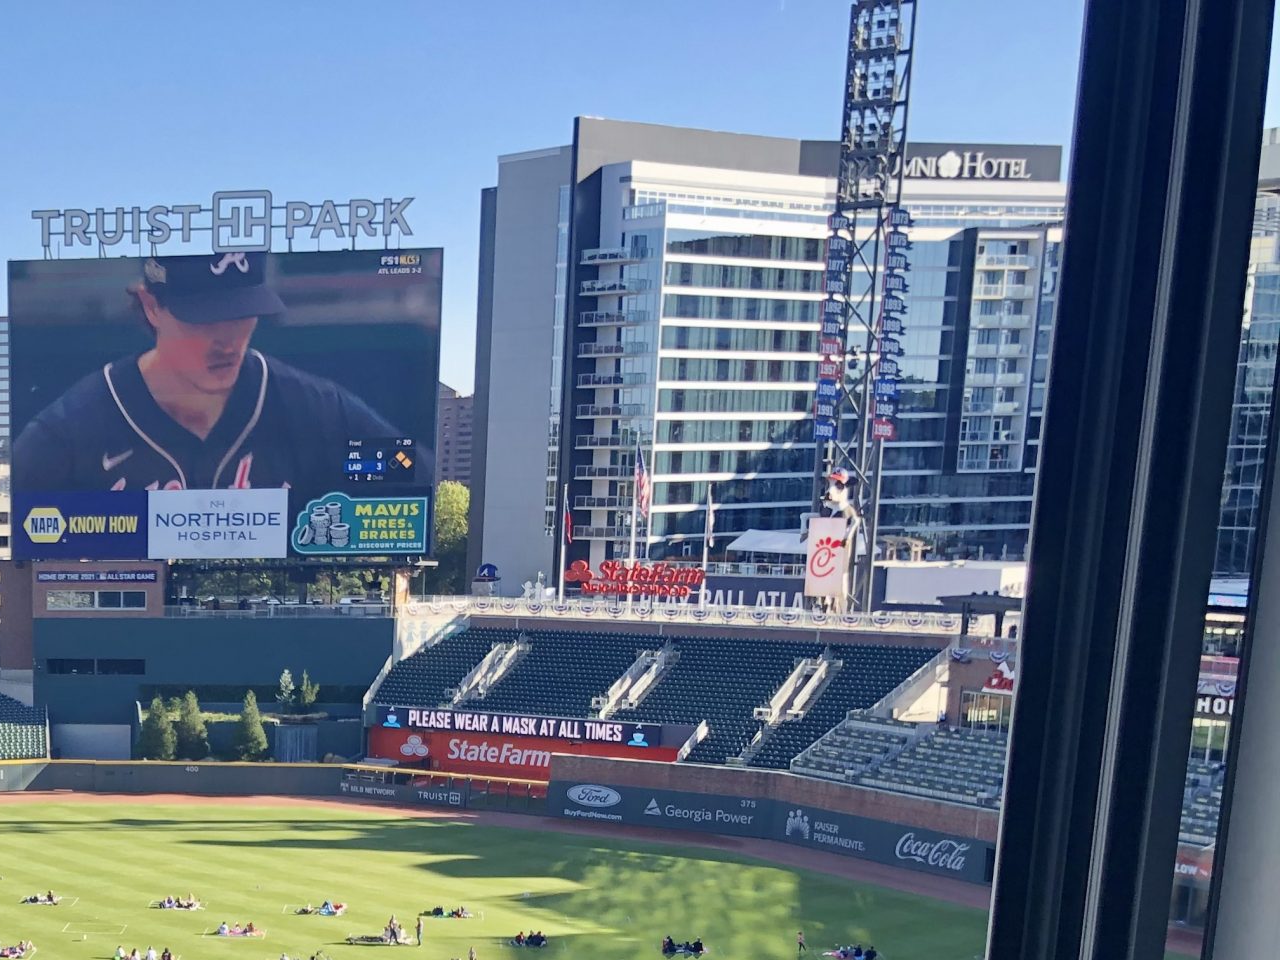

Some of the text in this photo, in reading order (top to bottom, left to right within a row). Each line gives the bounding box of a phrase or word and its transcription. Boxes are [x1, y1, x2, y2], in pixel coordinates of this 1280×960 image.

[32, 197, 415, 247] TRUIST PARK
[381, 256, 398, 265] FS1
[824, 322, 840, 334] 1897
[820, 364, 837, 375] 1957
[817, 404, 833, 416] 1991
[876, 403, 893, 415] 1992
[816, 425, 832, 436] 1993
[348, 451, 383, 460] ATL 0
[348, 463, 362, 471] LAD
[355, 503, 419, 517] MAVIS
[31, 517, 59, 534] NAPA
[69, 516, 138, 533] KNOW HOW
[156, 512, 281, 527] NORTHSIDE
[362, 519, 406, 529] TIRES
[178, 531, 257, 541] HOSPITAL
[359, 530, 415, 540] BRAKES
[408, 710, 622, 742] PLEASE WEAR A MASK AT ALL TIMES
[365, 787, 396, 796] NETWORK
[418, 791, 448, 801] TRUIST
[577, 789, 610, 803] Ford
[740, 799, 756, 809] 375
[564, 808, 622, 820] BuyFordNow.com
[665, 805, 754, 825] Georgia Power
[814, 821, 839, 835] KAISER
[813, 833, 864, 851] PERMANENTE
[895, 832, 970, 872] Coca-Cola
